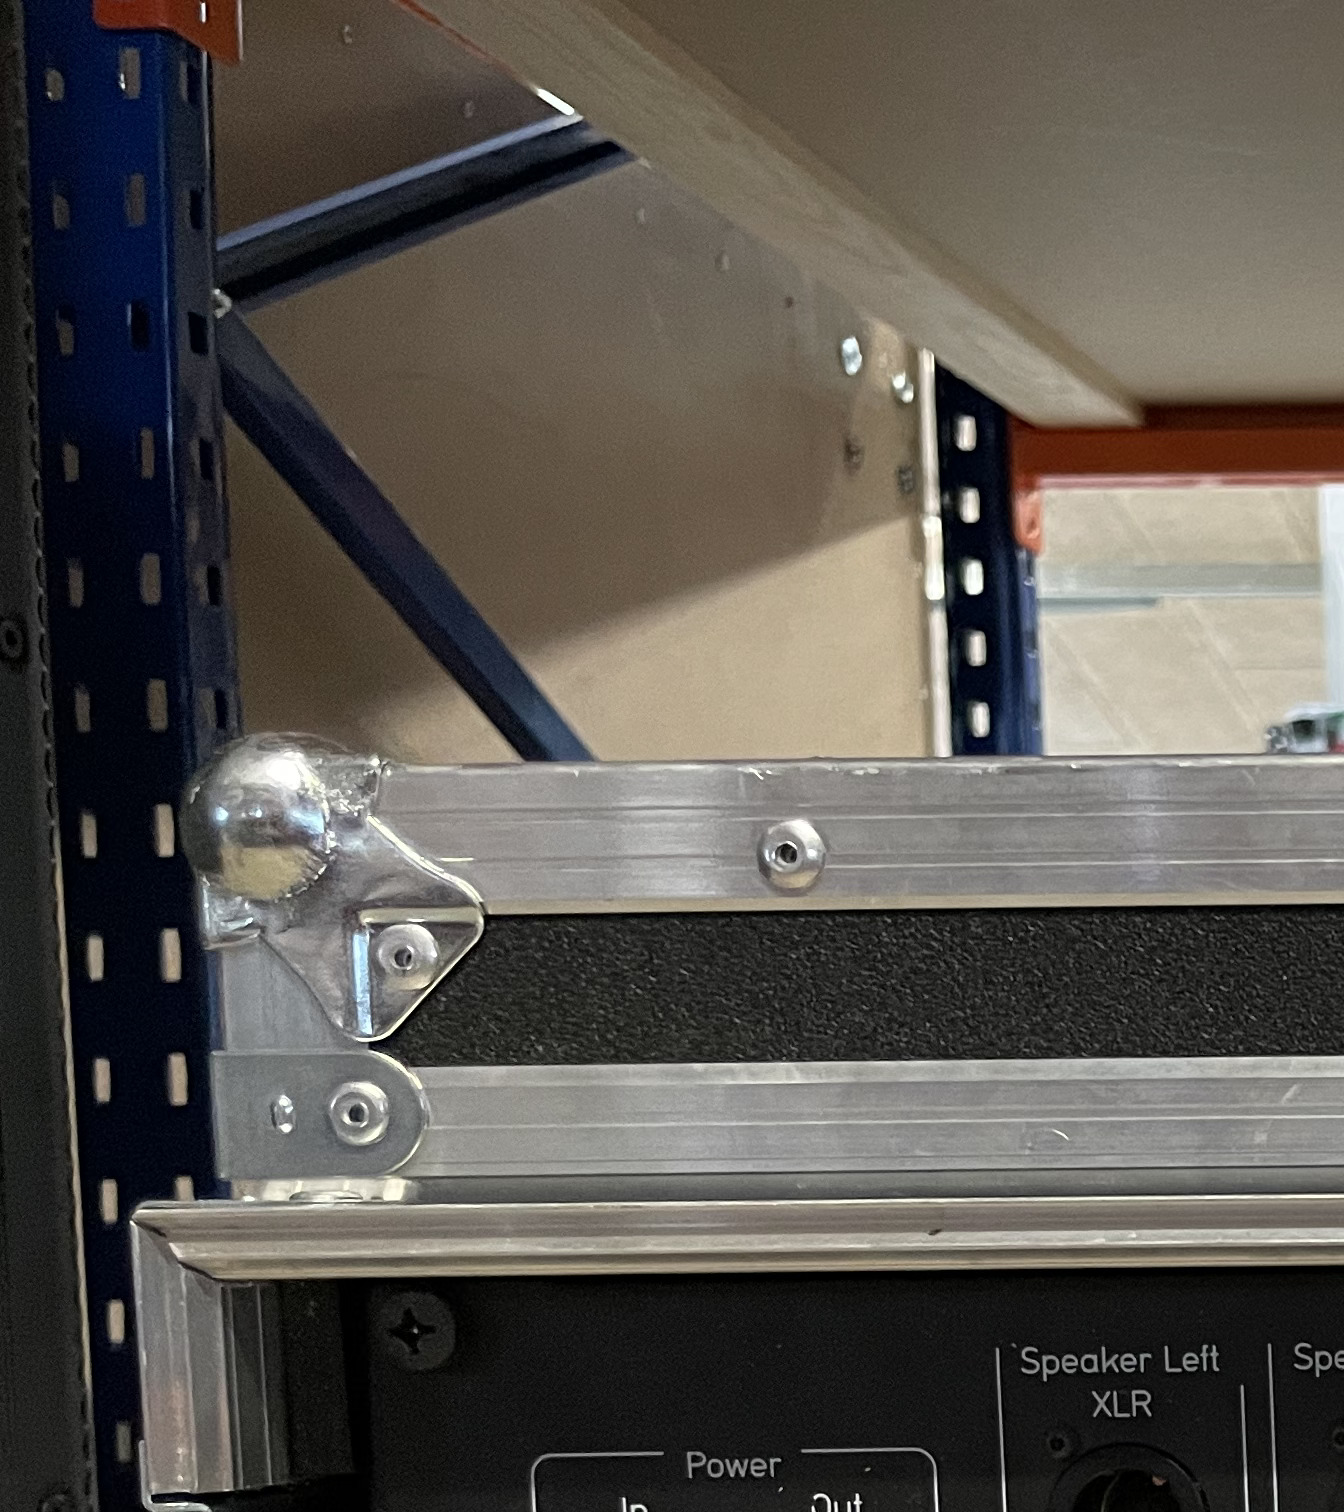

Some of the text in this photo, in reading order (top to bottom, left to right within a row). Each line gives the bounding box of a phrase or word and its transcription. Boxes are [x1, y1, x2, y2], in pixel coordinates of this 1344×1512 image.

[1020, 1344, 1220, 1382] Speaker Left
[1091, 1389, 1152, 1418] XLR
[686, 1451, 782, 1479] Power
